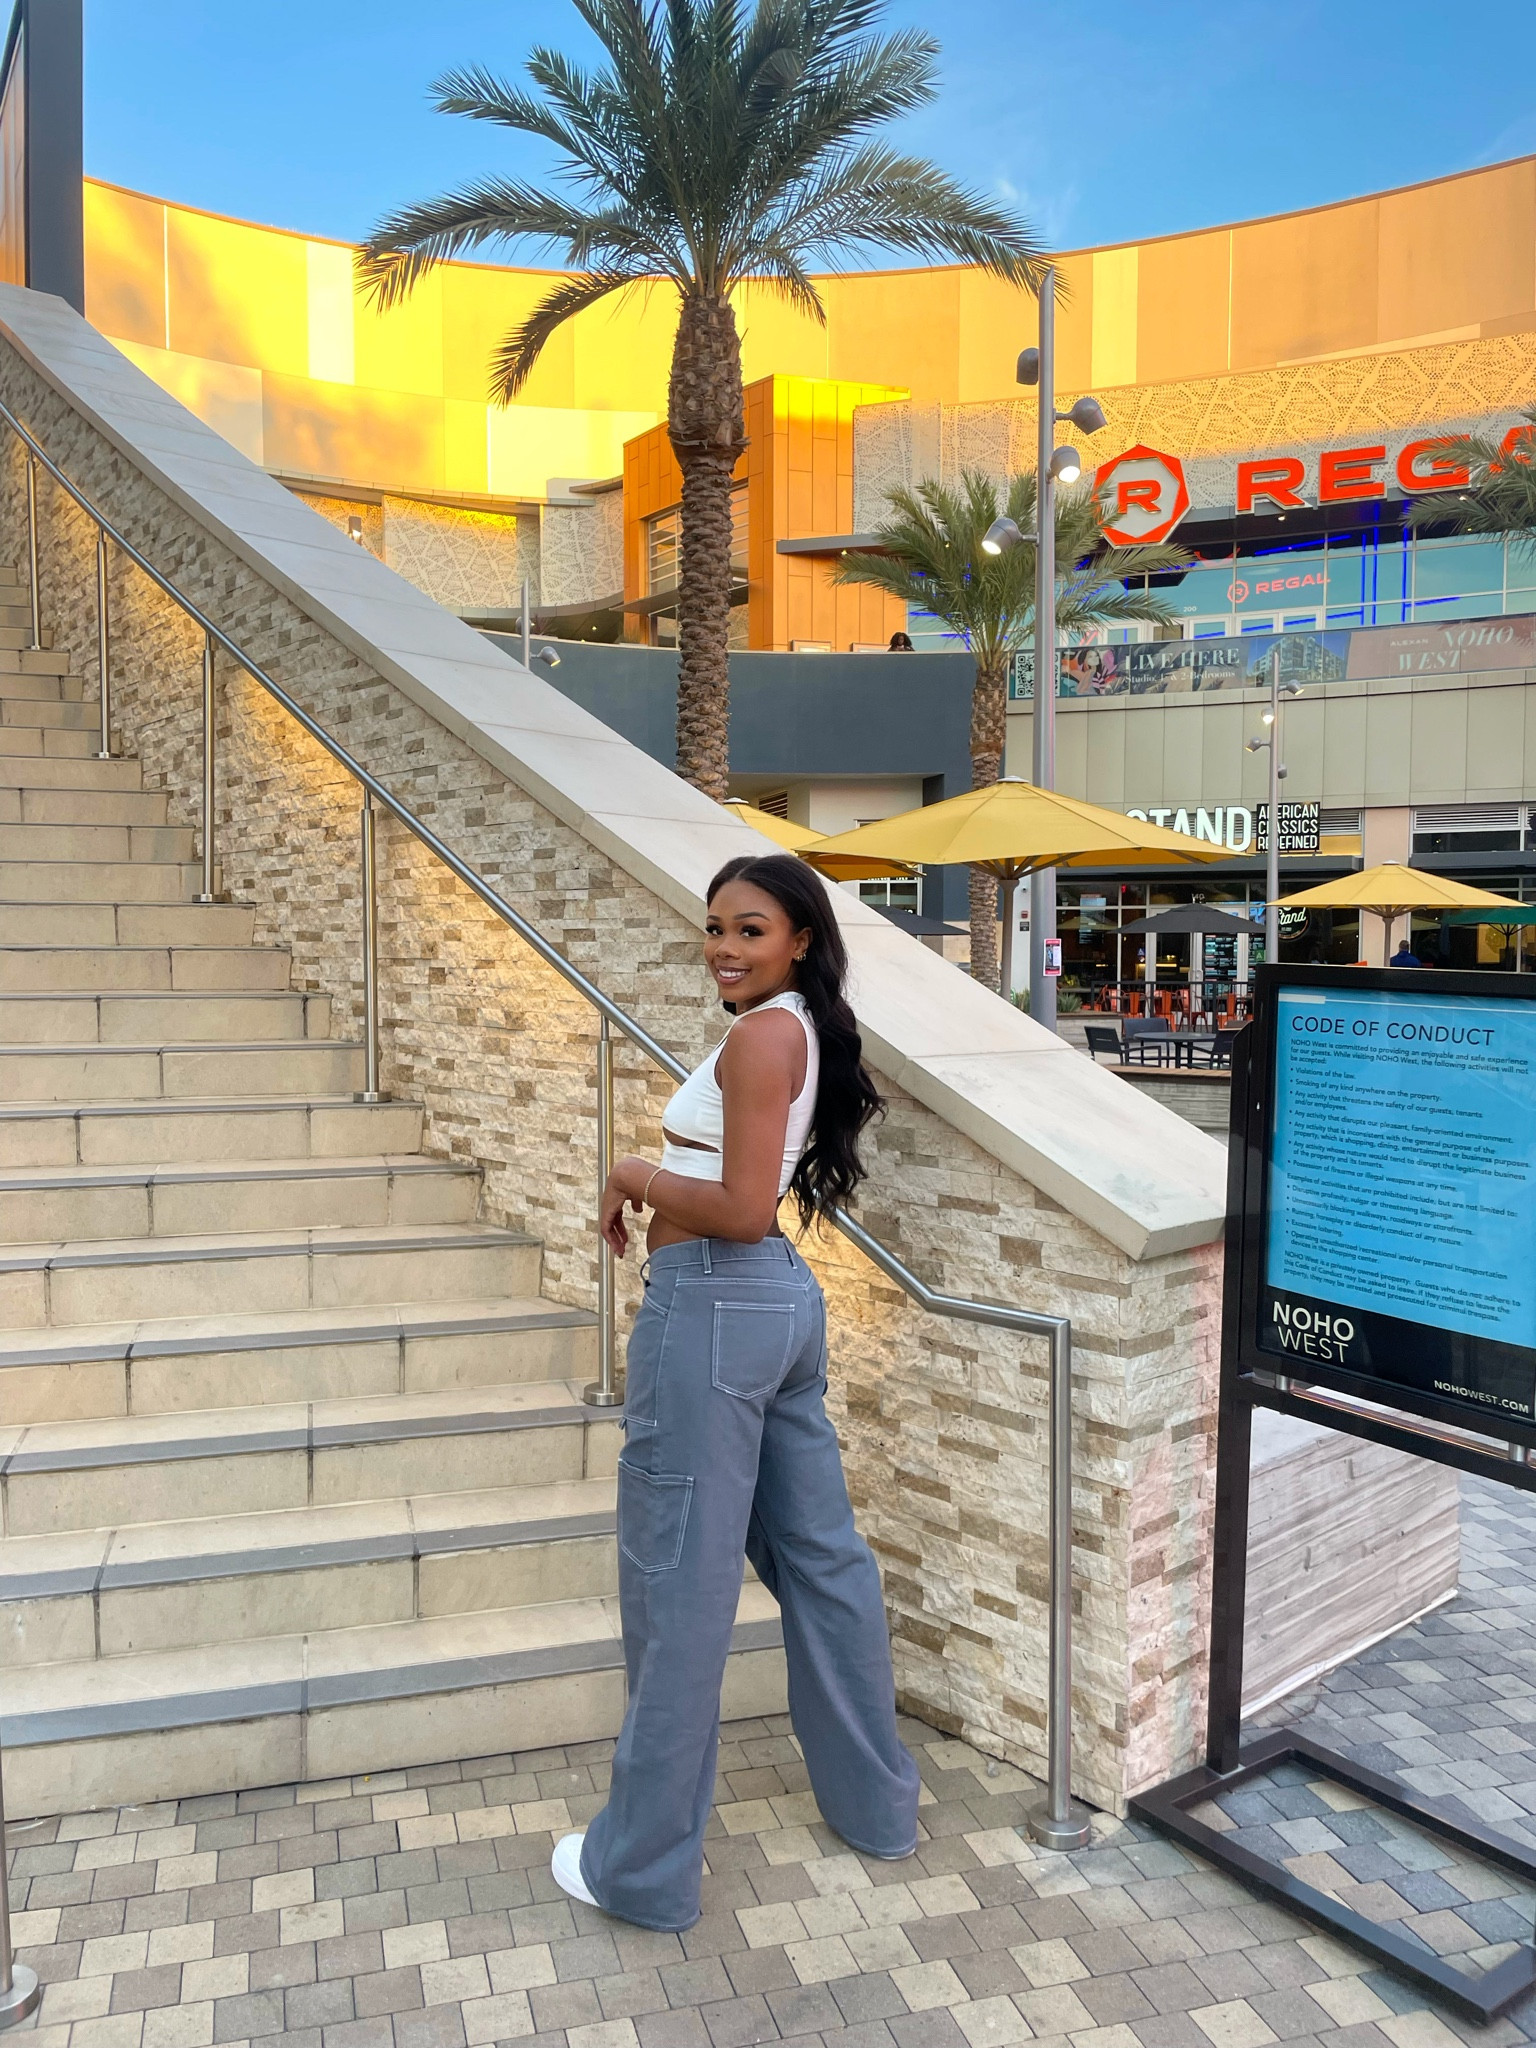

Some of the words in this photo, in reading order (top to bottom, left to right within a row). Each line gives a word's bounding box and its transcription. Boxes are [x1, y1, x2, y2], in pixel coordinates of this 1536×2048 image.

[1117, 479, 1162, 514] R
[1255, 573, 1331, 595] REGAL
[1390, 638, 1429, 647] ALEXAN
[1445, 625, 1514, 648] NOHO
[1125, 652, 1174, 670] LIVE
[1181, 648, 1240, 667] HERE
[1399, 649, 1467, 671] WEST
[1258, 803, 1319, 820] AERICAN
[1258, 819, 1318, 835] CSSICS
[1257, 834, 1318, 850] REEFINED
[1292, 1015, 1344, 1034] CODE
[1352, 1020, 1380, 1037] OF
[1386, 1022, 1495, 1046] CONDUCT
[1352, 1052, 1374, 1062] visiting
[1376, 1054, 1399, 1062] NOHO
[1434, 1059, 1466, 1070] following
[1468, 1063, 1499, 1071] activities
[1379, 1047, 1409, 1056] providing
[1421, 1050, 1453, 1059] enjoyable
[1488, 1057, 1528, 1065] experience
[1296, 1067, 1323, 1076] Violations
[1296, 1079, 1319, 1089] Smoking
[1273, 1301, 1355, 1342] NOHO
[1278, 1325, 1348, 1362] WEST
[1434, 1380, 1529, 1414] NOHOWEST.COM
